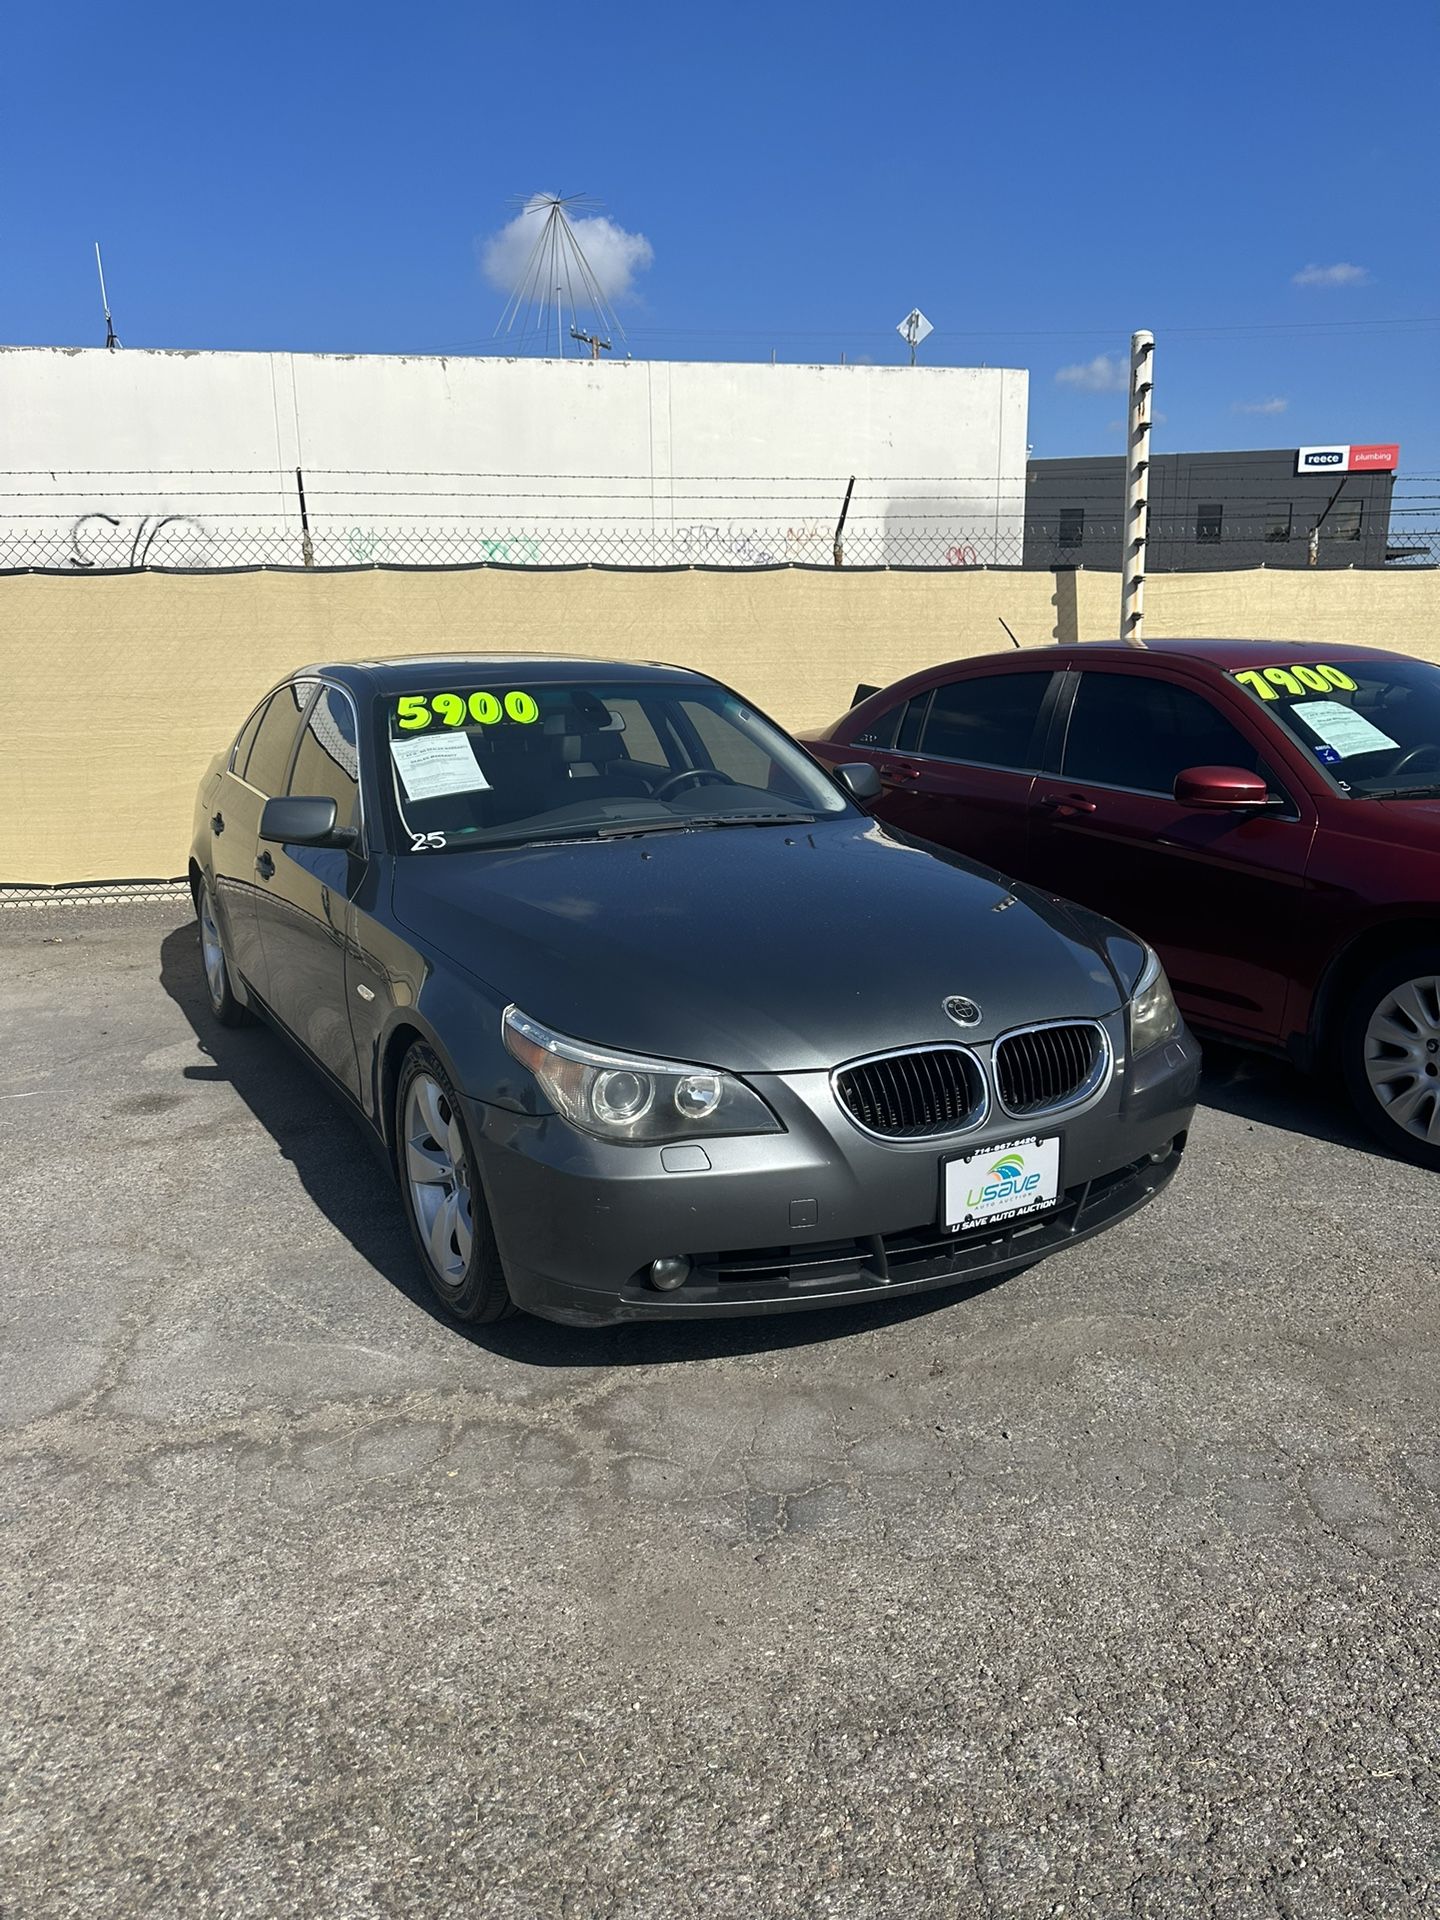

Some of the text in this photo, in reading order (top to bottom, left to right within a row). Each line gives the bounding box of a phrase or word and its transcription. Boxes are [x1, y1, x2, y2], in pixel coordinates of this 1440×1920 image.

[1308, 452, 1392, 463] reece plumbing
[1234, 664, 1358, 701] 7900
[397, 691, 539, 729] 5900
[410, 831, 447, 851] 25
[974, 1192, 1032, 1211] AUTO AUCTION
[951, 1199, 1057, 1233] U SAVE AUTO AUCTION
